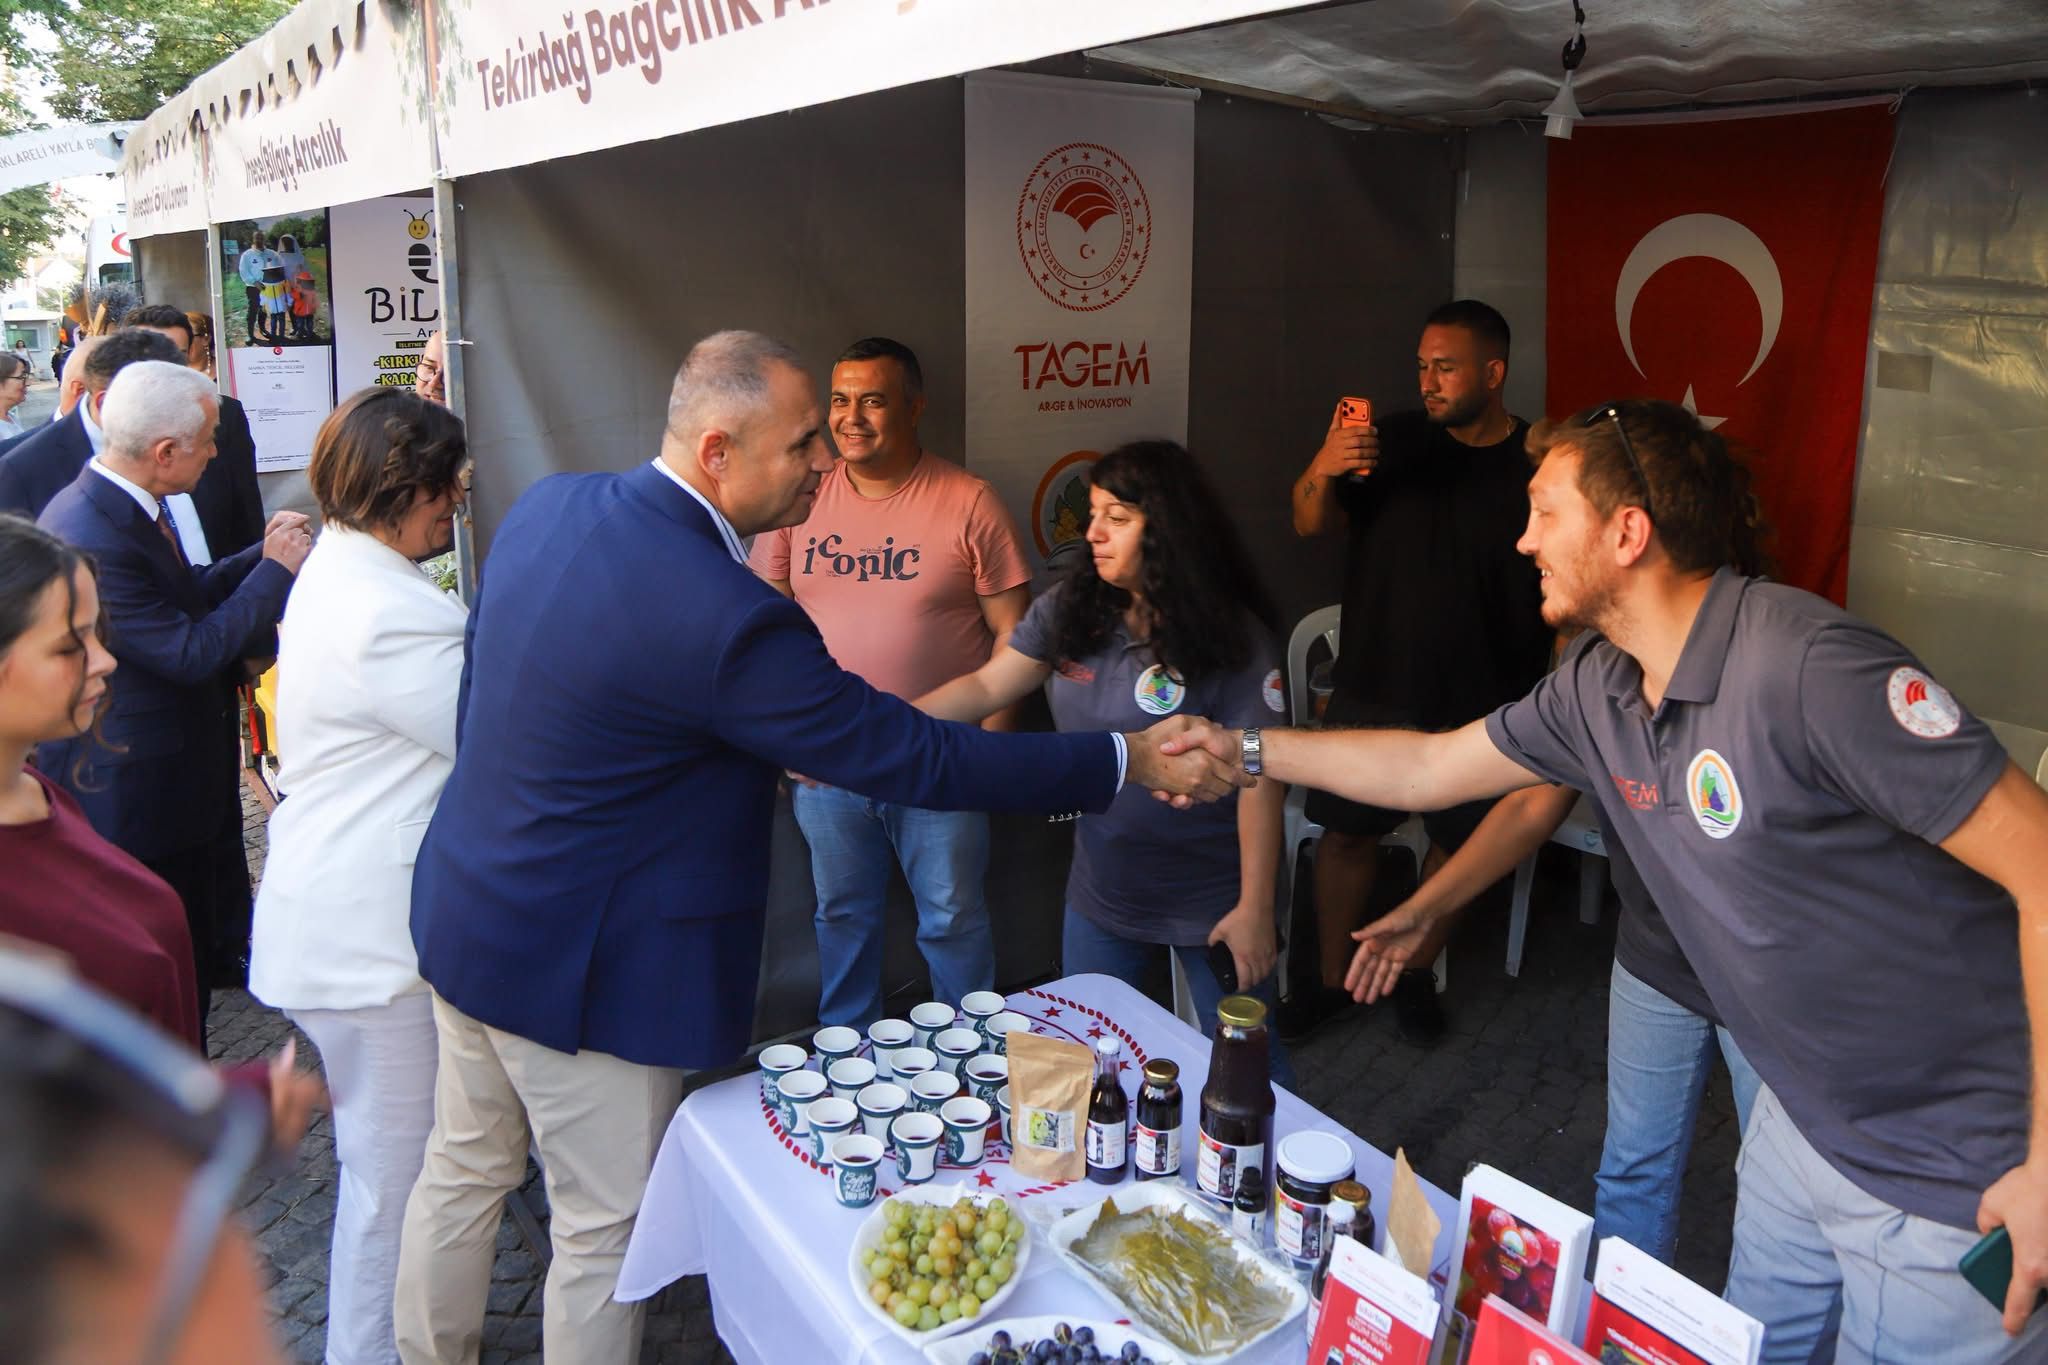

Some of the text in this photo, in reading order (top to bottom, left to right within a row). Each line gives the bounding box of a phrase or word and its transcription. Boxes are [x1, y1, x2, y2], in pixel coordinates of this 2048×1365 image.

[477, 12, 592, 112] Tekirdağ
[49, 140, 84, 156] YAYLA
[292, 118, 349, 175] Arıcılık
[1075, 168, 1101, 178] TARIM
[364, 286, 439, 324] BiL
[1014, 339, 1150, 390] TAGEM
[1067, 400, 1076, 411] &
[1077, 397, 1132, 410] İNOVASYON
